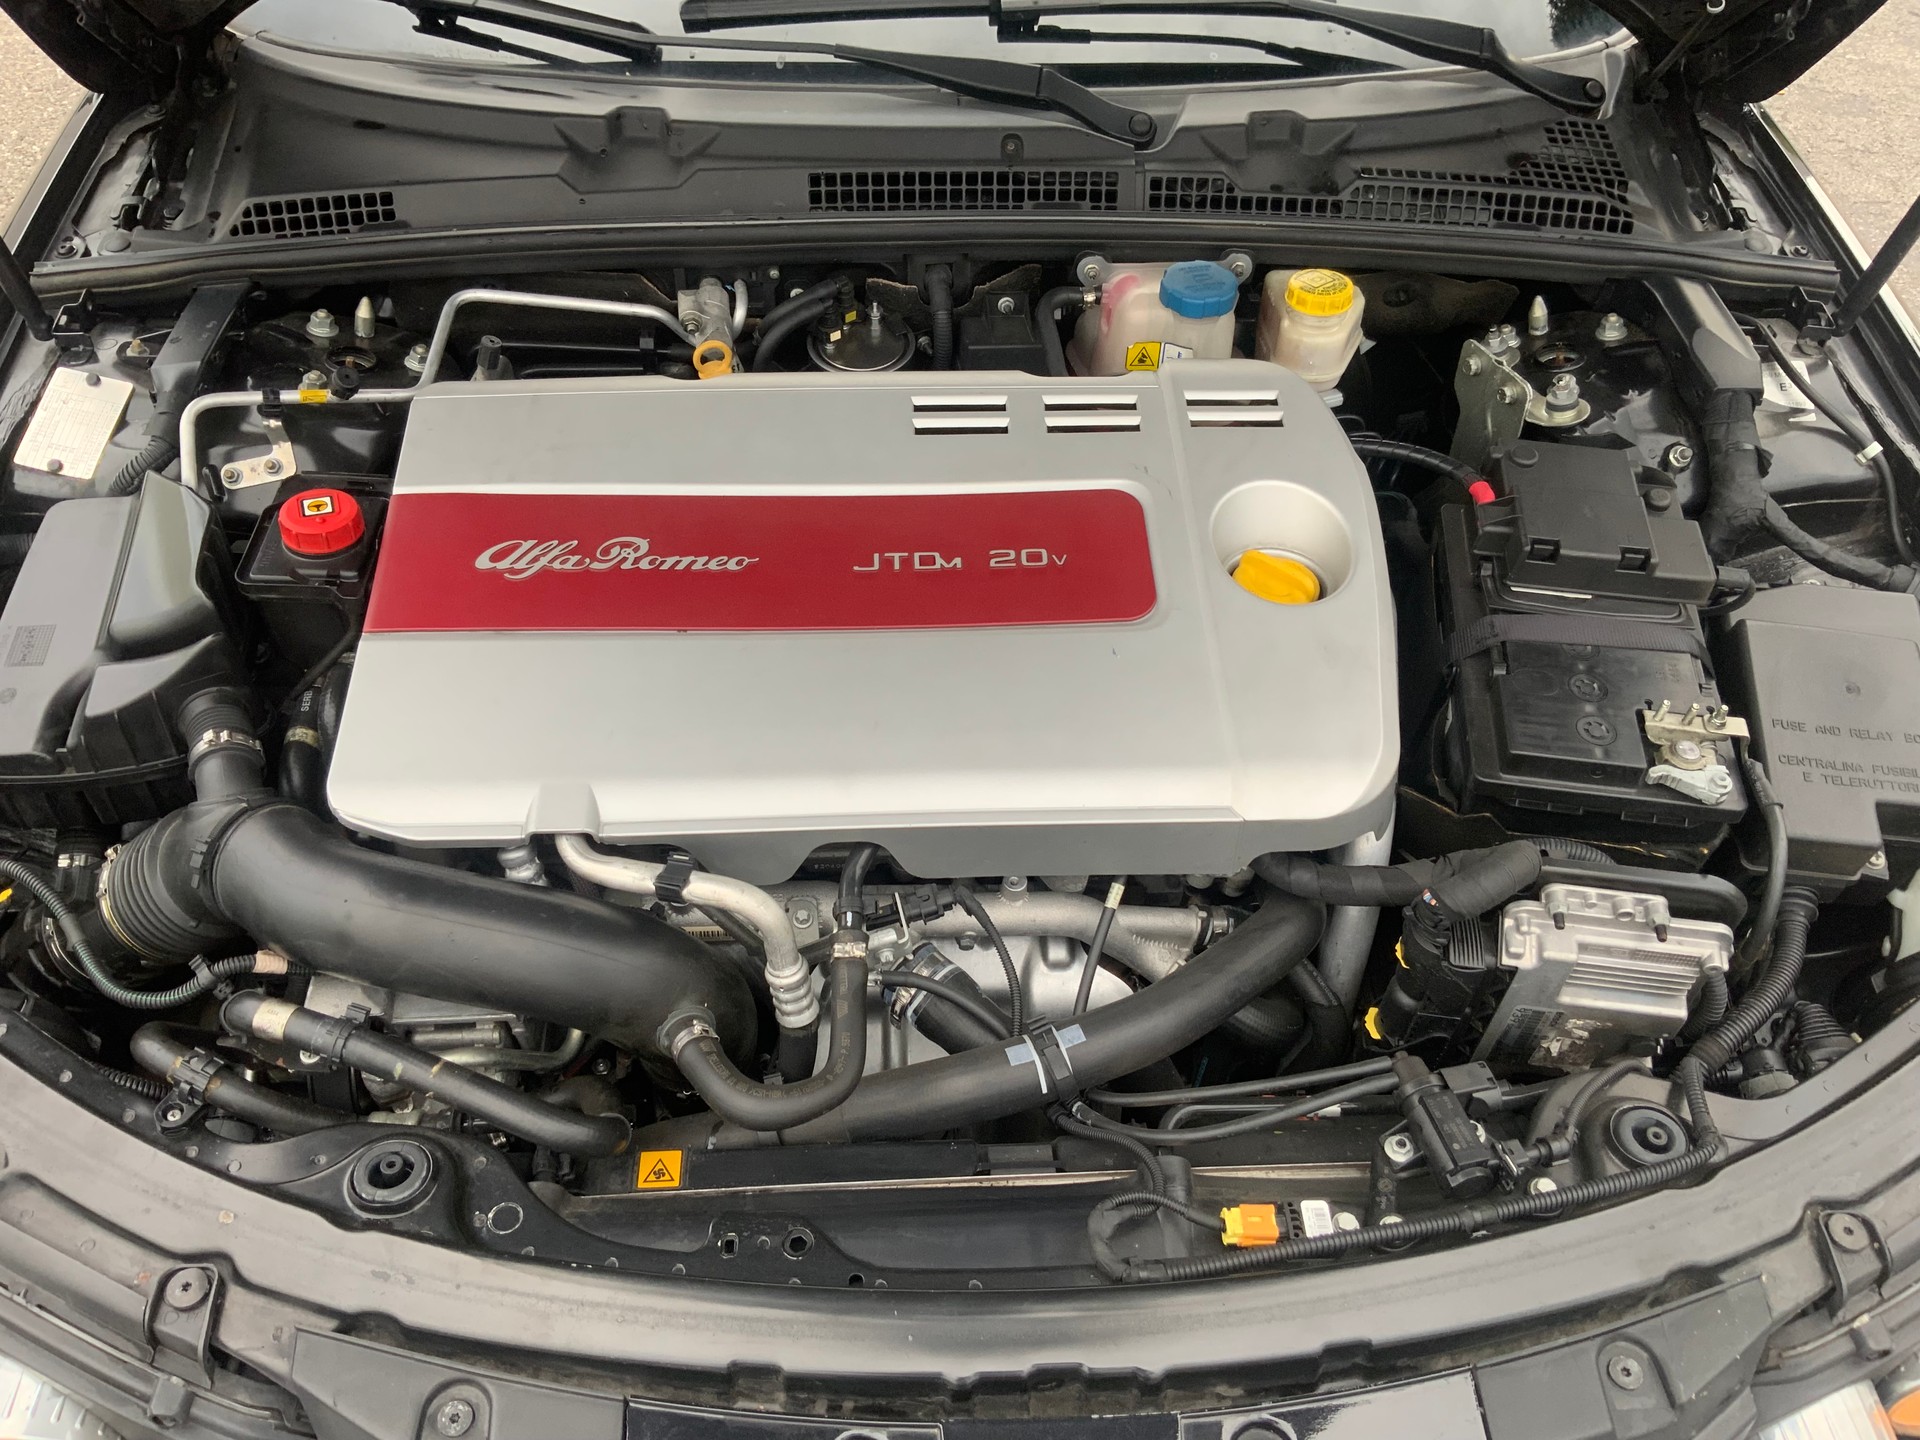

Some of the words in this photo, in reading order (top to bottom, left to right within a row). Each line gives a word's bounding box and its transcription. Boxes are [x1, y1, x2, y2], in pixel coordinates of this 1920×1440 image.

[474, 539, 591, 581] Alfa
[589, 536, 760, 573] Romeo
[1771, 718, 1808, 733] FUSE
[1815, 725, 1841, 737] AND
[1849, 727, 1894, 742] RELAY
[1778, 753, 1865, 774] CENTRALINA
[1802, 771, 1813, 783] E
[1820, 772, 1920, 794] TELERUTTORI
